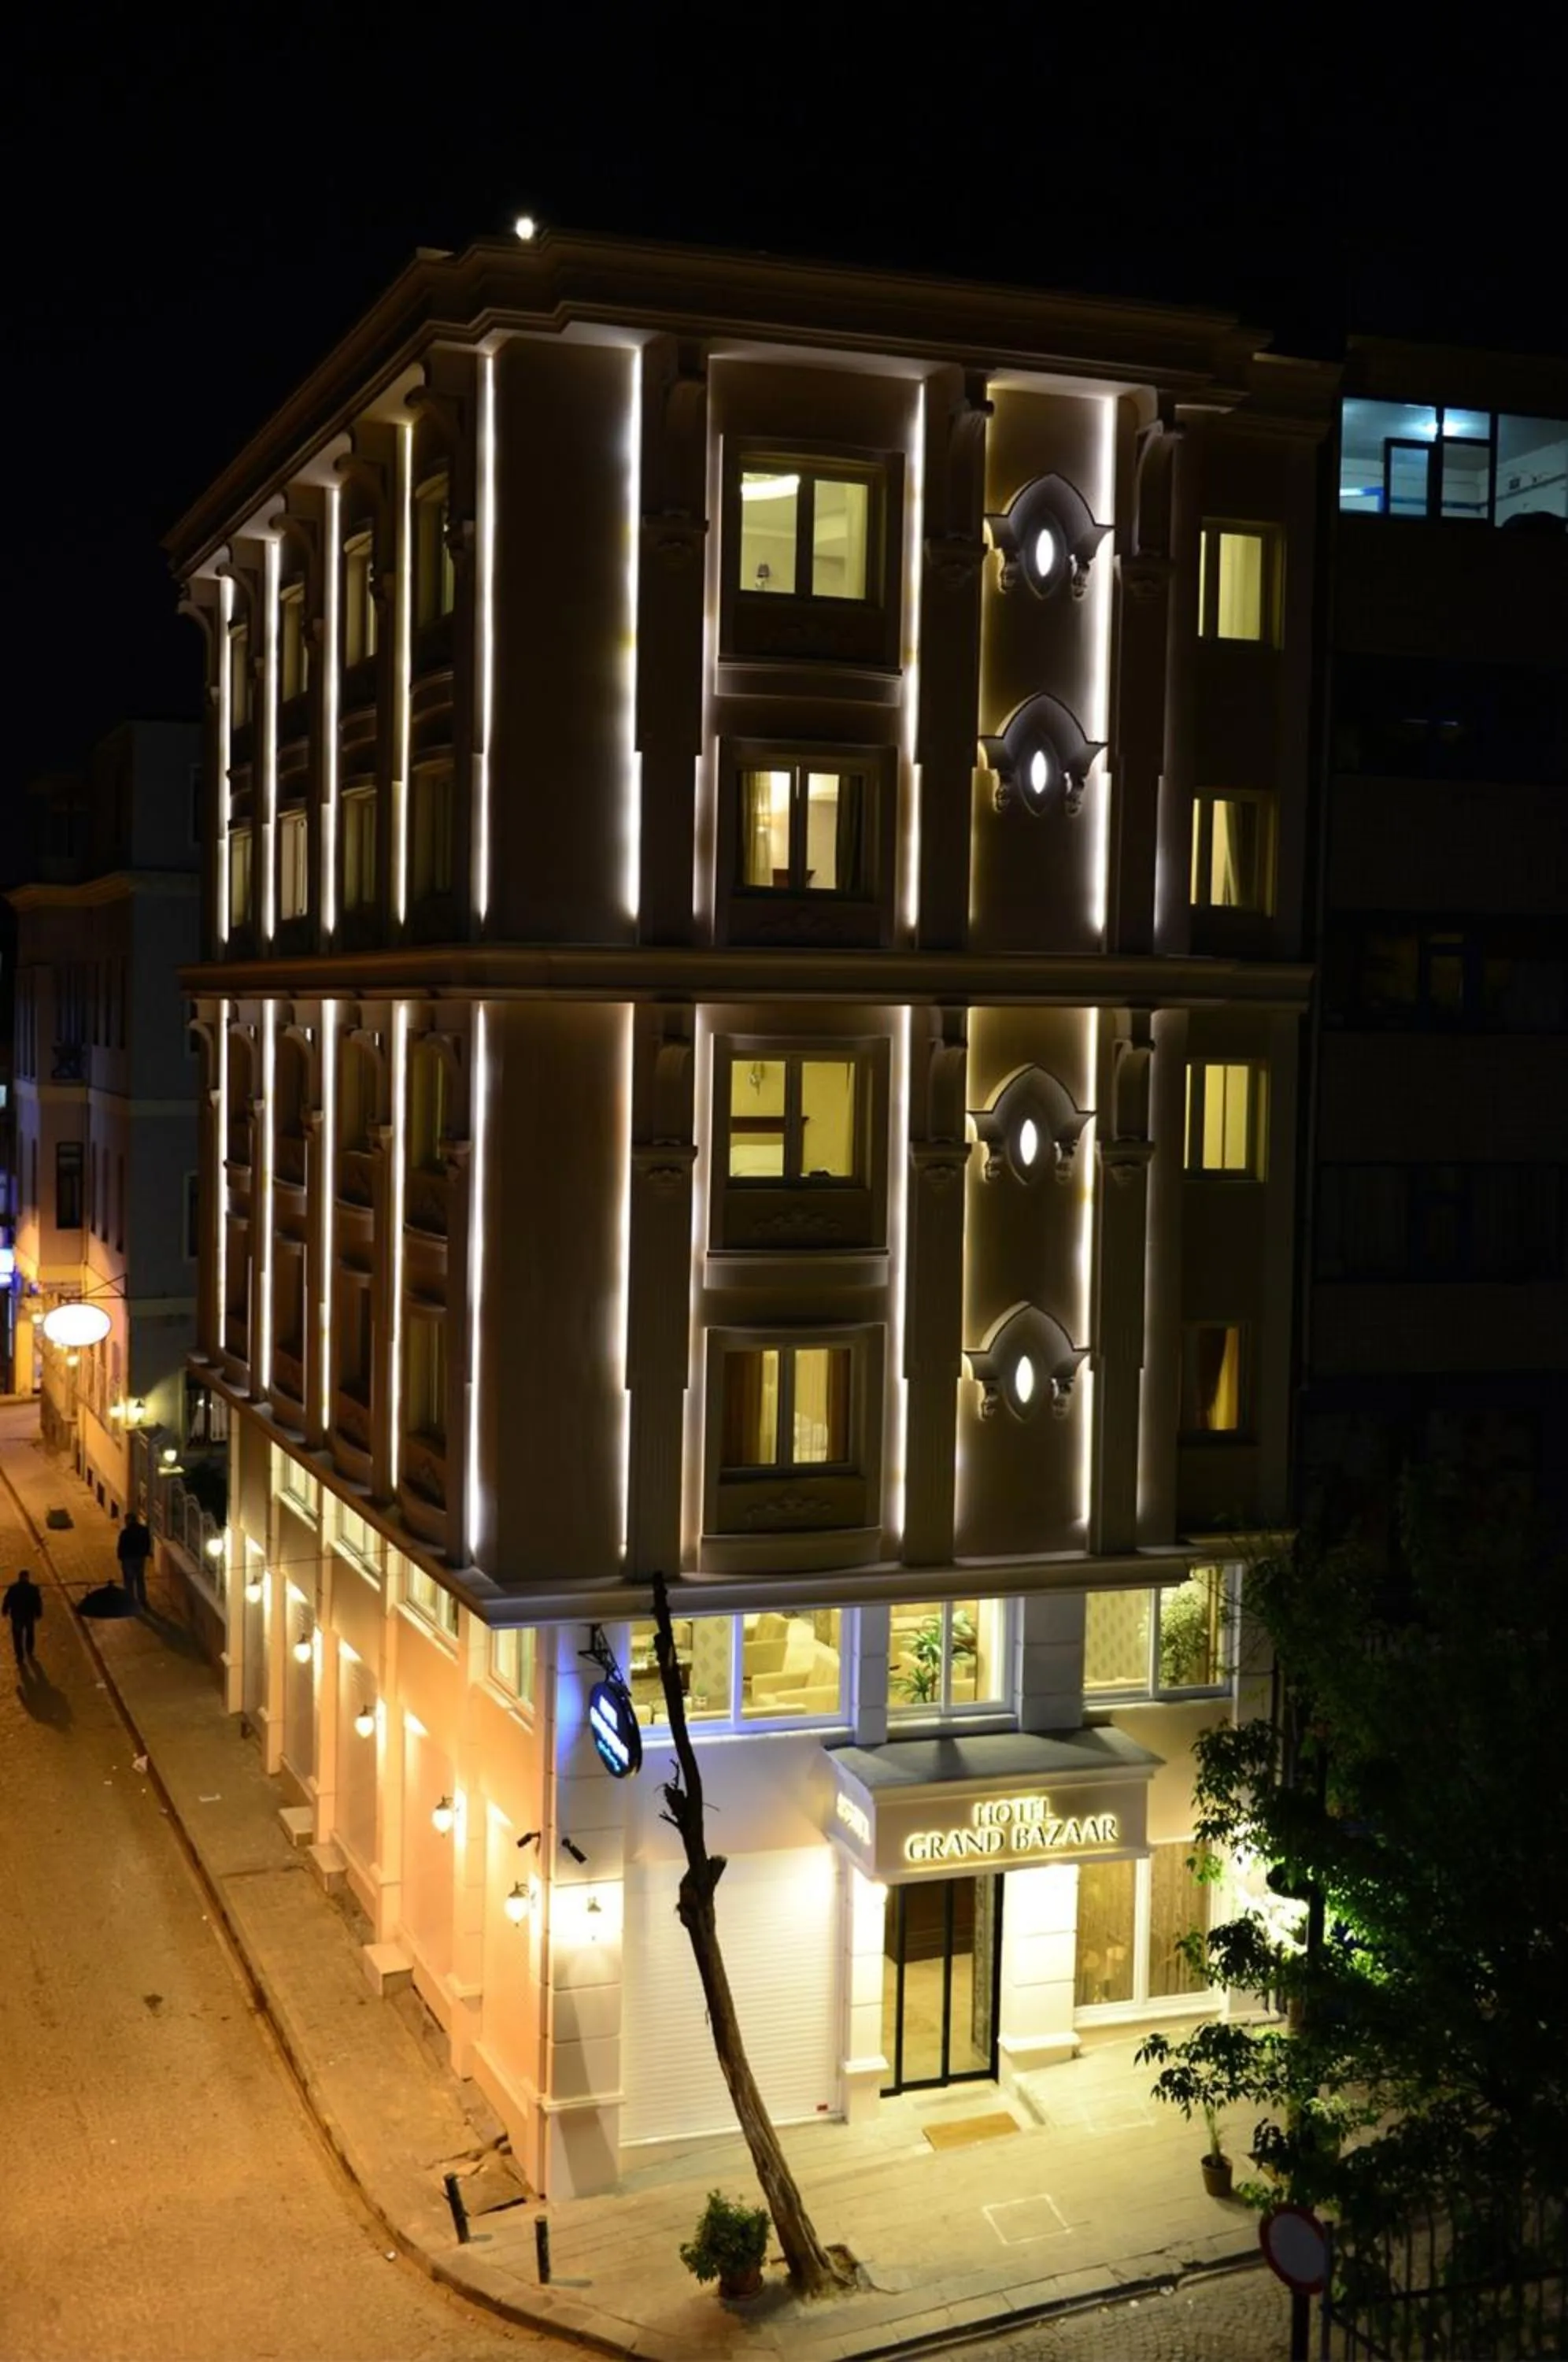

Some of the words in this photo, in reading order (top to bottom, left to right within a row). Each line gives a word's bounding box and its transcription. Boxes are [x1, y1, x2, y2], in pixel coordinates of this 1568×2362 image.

[974, 1797, 1052, 1827] HOTEL
[906, 1831, 1004, 1860] GRAND
[1012, 1815, 1119, 1851] BAZAAR
